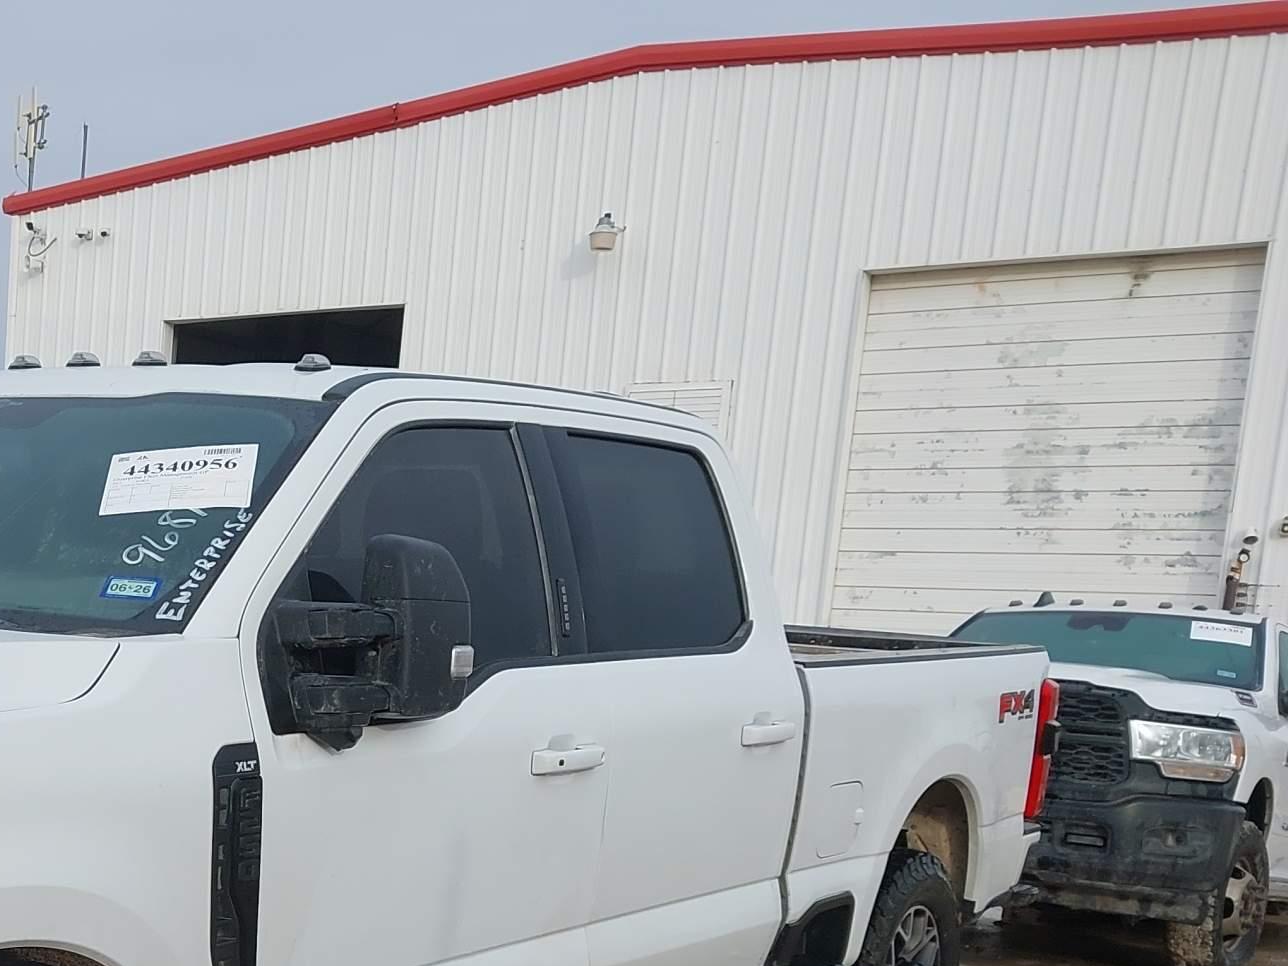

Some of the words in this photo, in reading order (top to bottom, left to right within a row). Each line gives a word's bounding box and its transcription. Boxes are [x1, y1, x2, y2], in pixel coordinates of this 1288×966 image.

[123, 457, 240, 476] 44340956
[998, 688, 1035, 724] FX4
[235, 760, 257, 773] XLT
